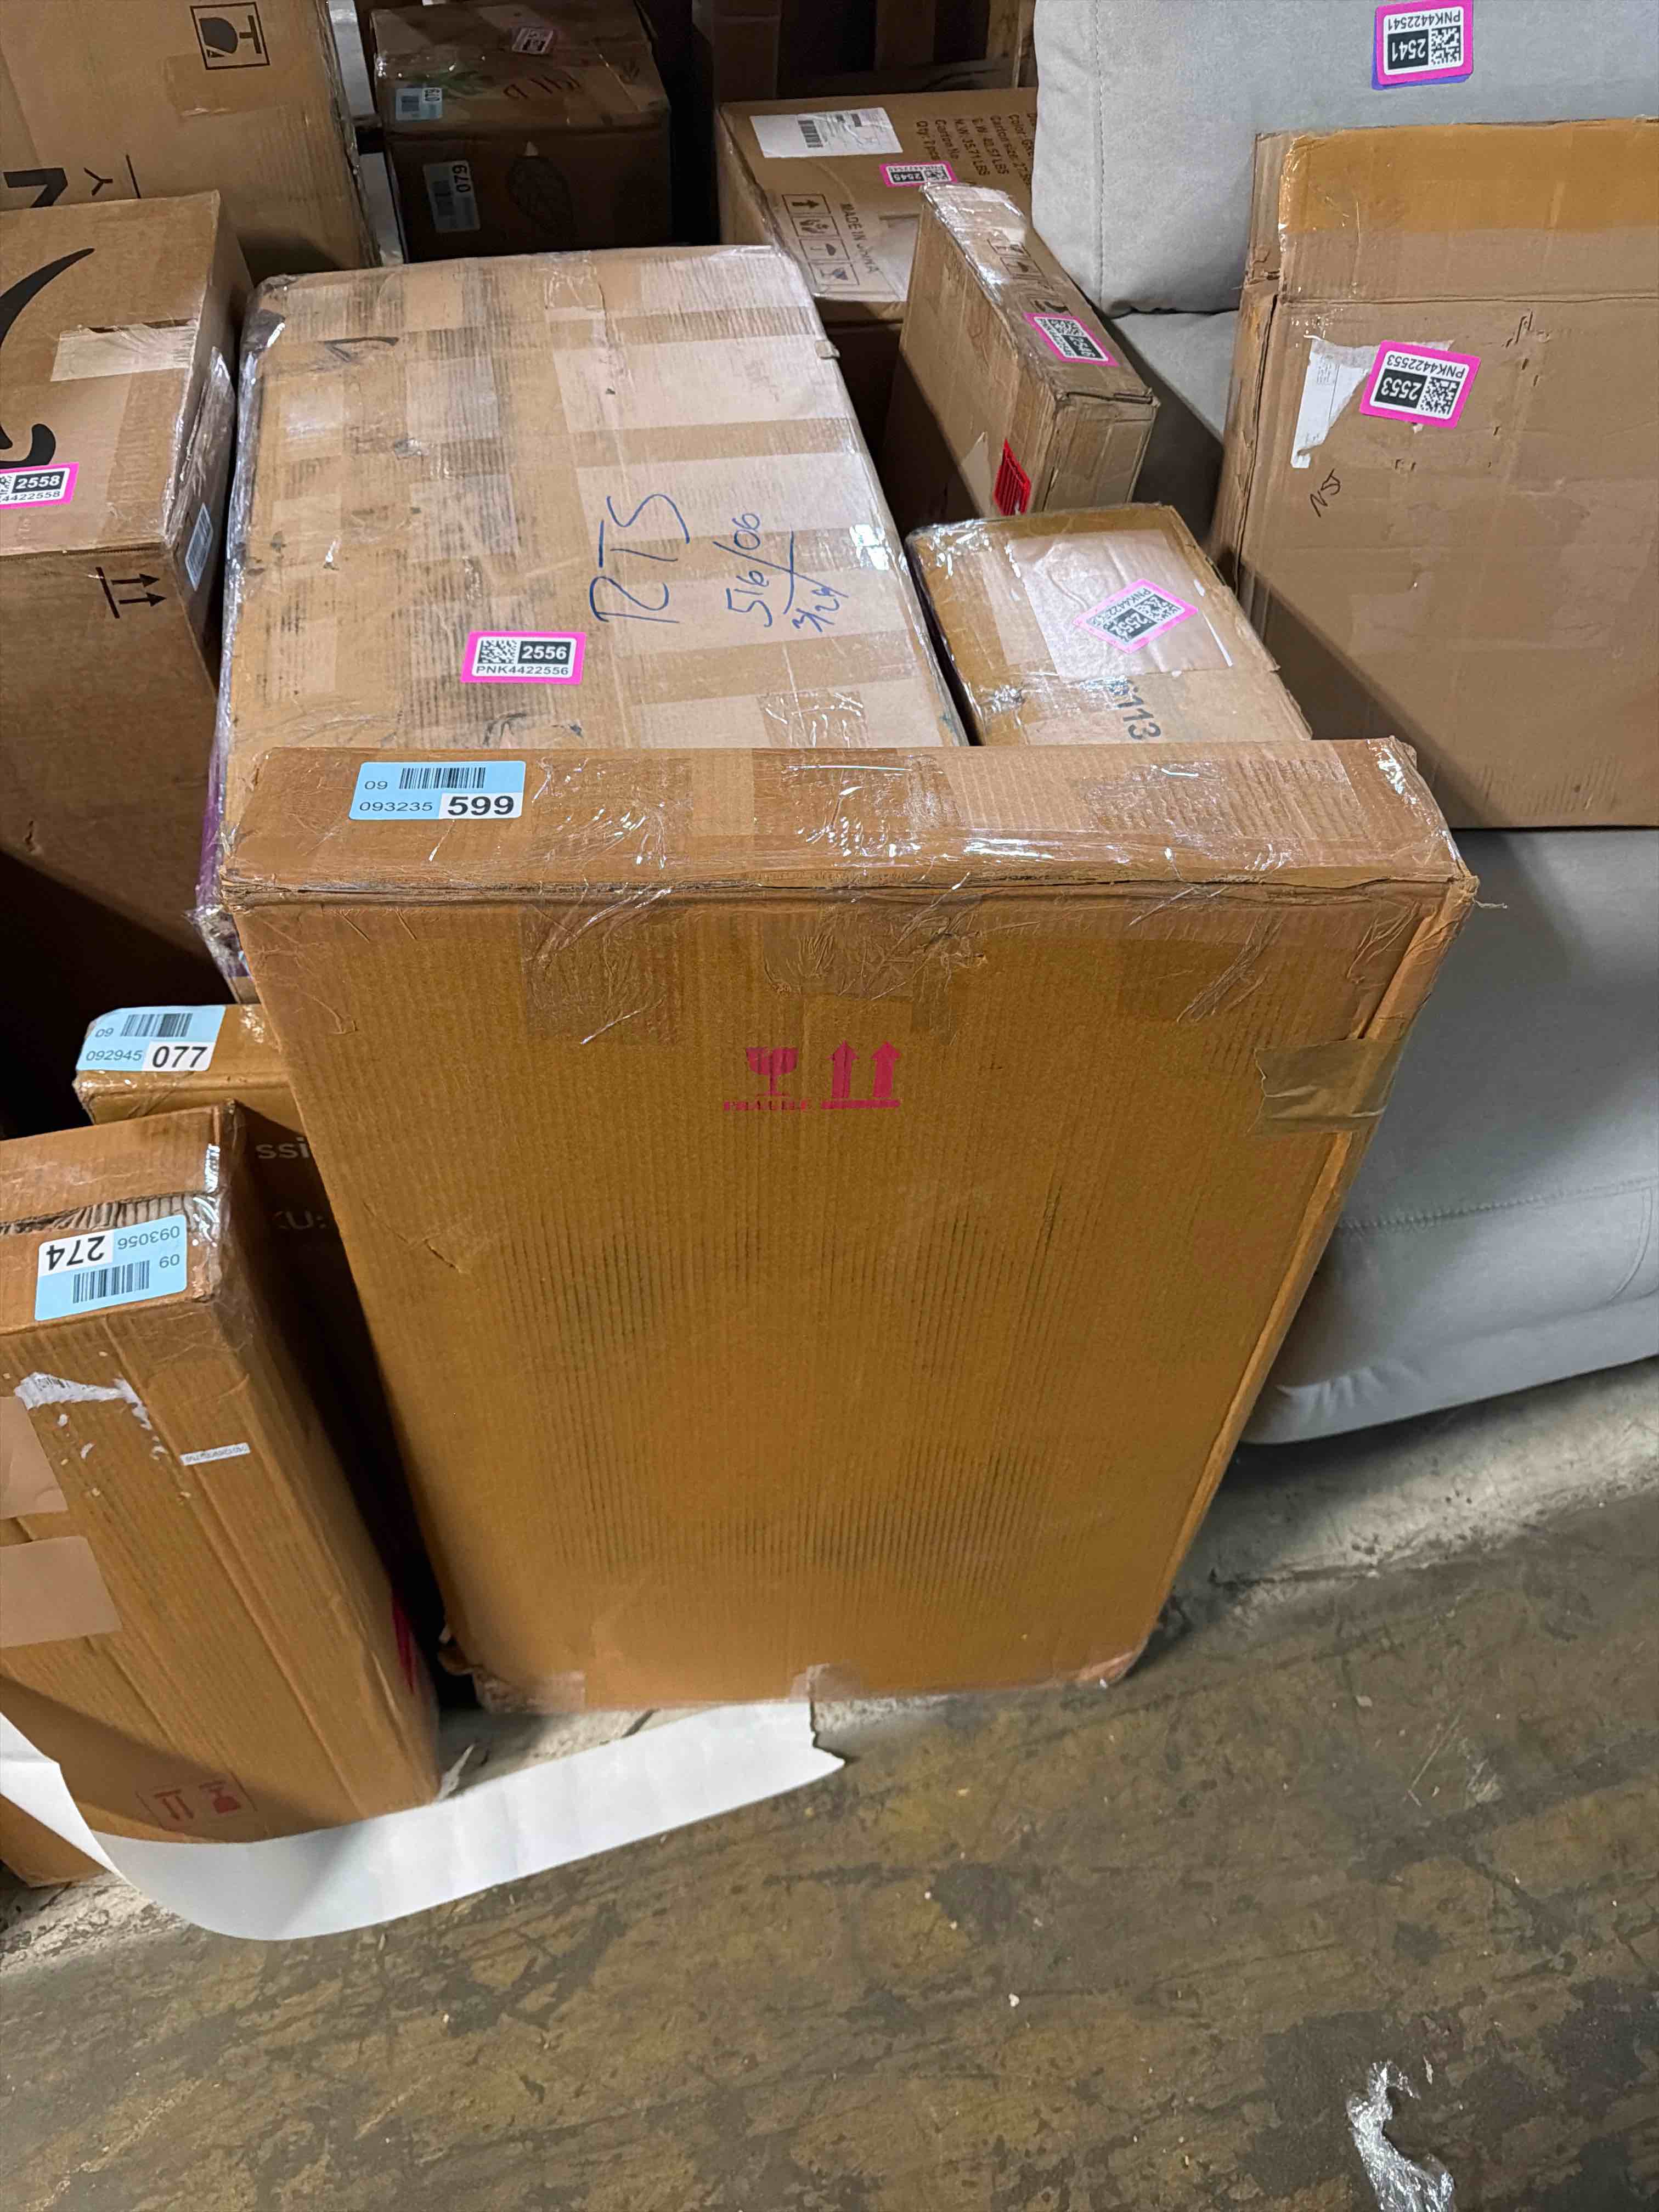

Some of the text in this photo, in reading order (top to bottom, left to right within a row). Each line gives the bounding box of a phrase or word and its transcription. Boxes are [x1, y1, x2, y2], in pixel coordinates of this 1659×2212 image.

[1388, 10, 1461, 31] PNK4422541
[1392, 38, 1426, 61] 2541
[452, 165, 471, 193] 079
[840, 203, 862, 229] MADE
[851, 231, 867, 241] IN
[1387, 354, 1466, 379] PNK4422553
[1381, 377, 1423, 401] 2553
[15, 475, 61, 489] 2558
[590, 493, 690, 624] RTS
[522, 646, 567, 659] 2556
[476, 665, 568, 675] PNK4422556
[364, 781, 388, 789] 09
[359, 795, 514, 816] 093235 599
[94, 1028, 114, 1038] 09
[86, 1046, 208, 1068] 092945 077
[46, 1226, 180, 1271] 093056 274
[159, 1254, 180, 1268] 09
